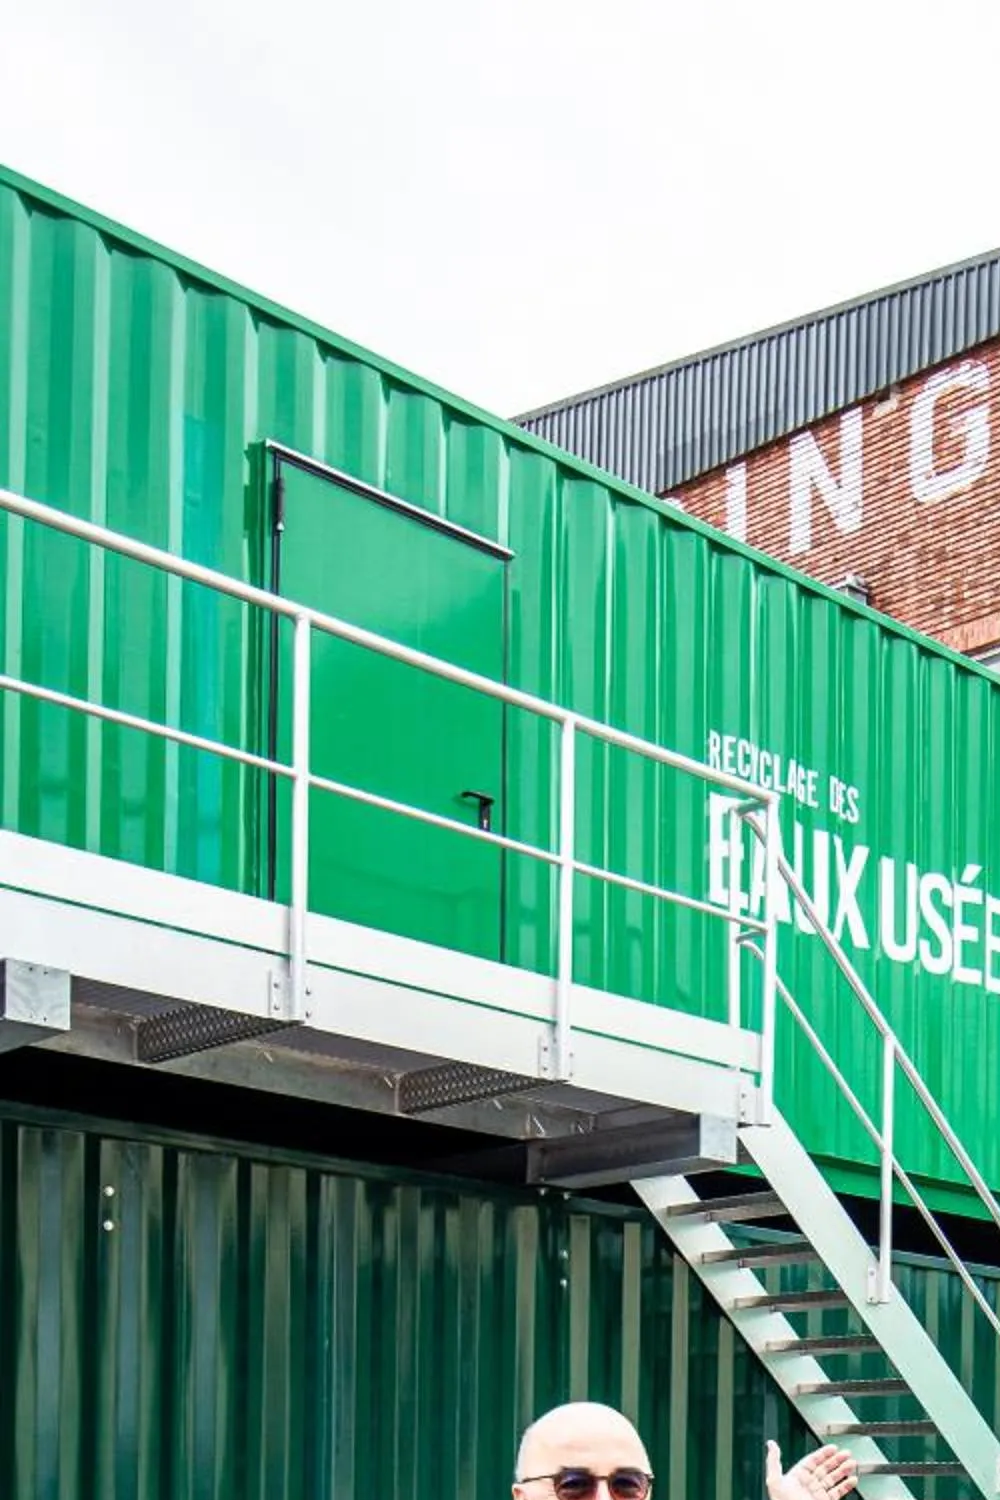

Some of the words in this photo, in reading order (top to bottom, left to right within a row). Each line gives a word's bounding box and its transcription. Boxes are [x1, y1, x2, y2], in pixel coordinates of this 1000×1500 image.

[664, 359, 991, 555] ING
[708, 729, 819, 808] RECYCLAGE
[829, 775, 860, 823] DES
[708, 791, 870, 949] EAUX
